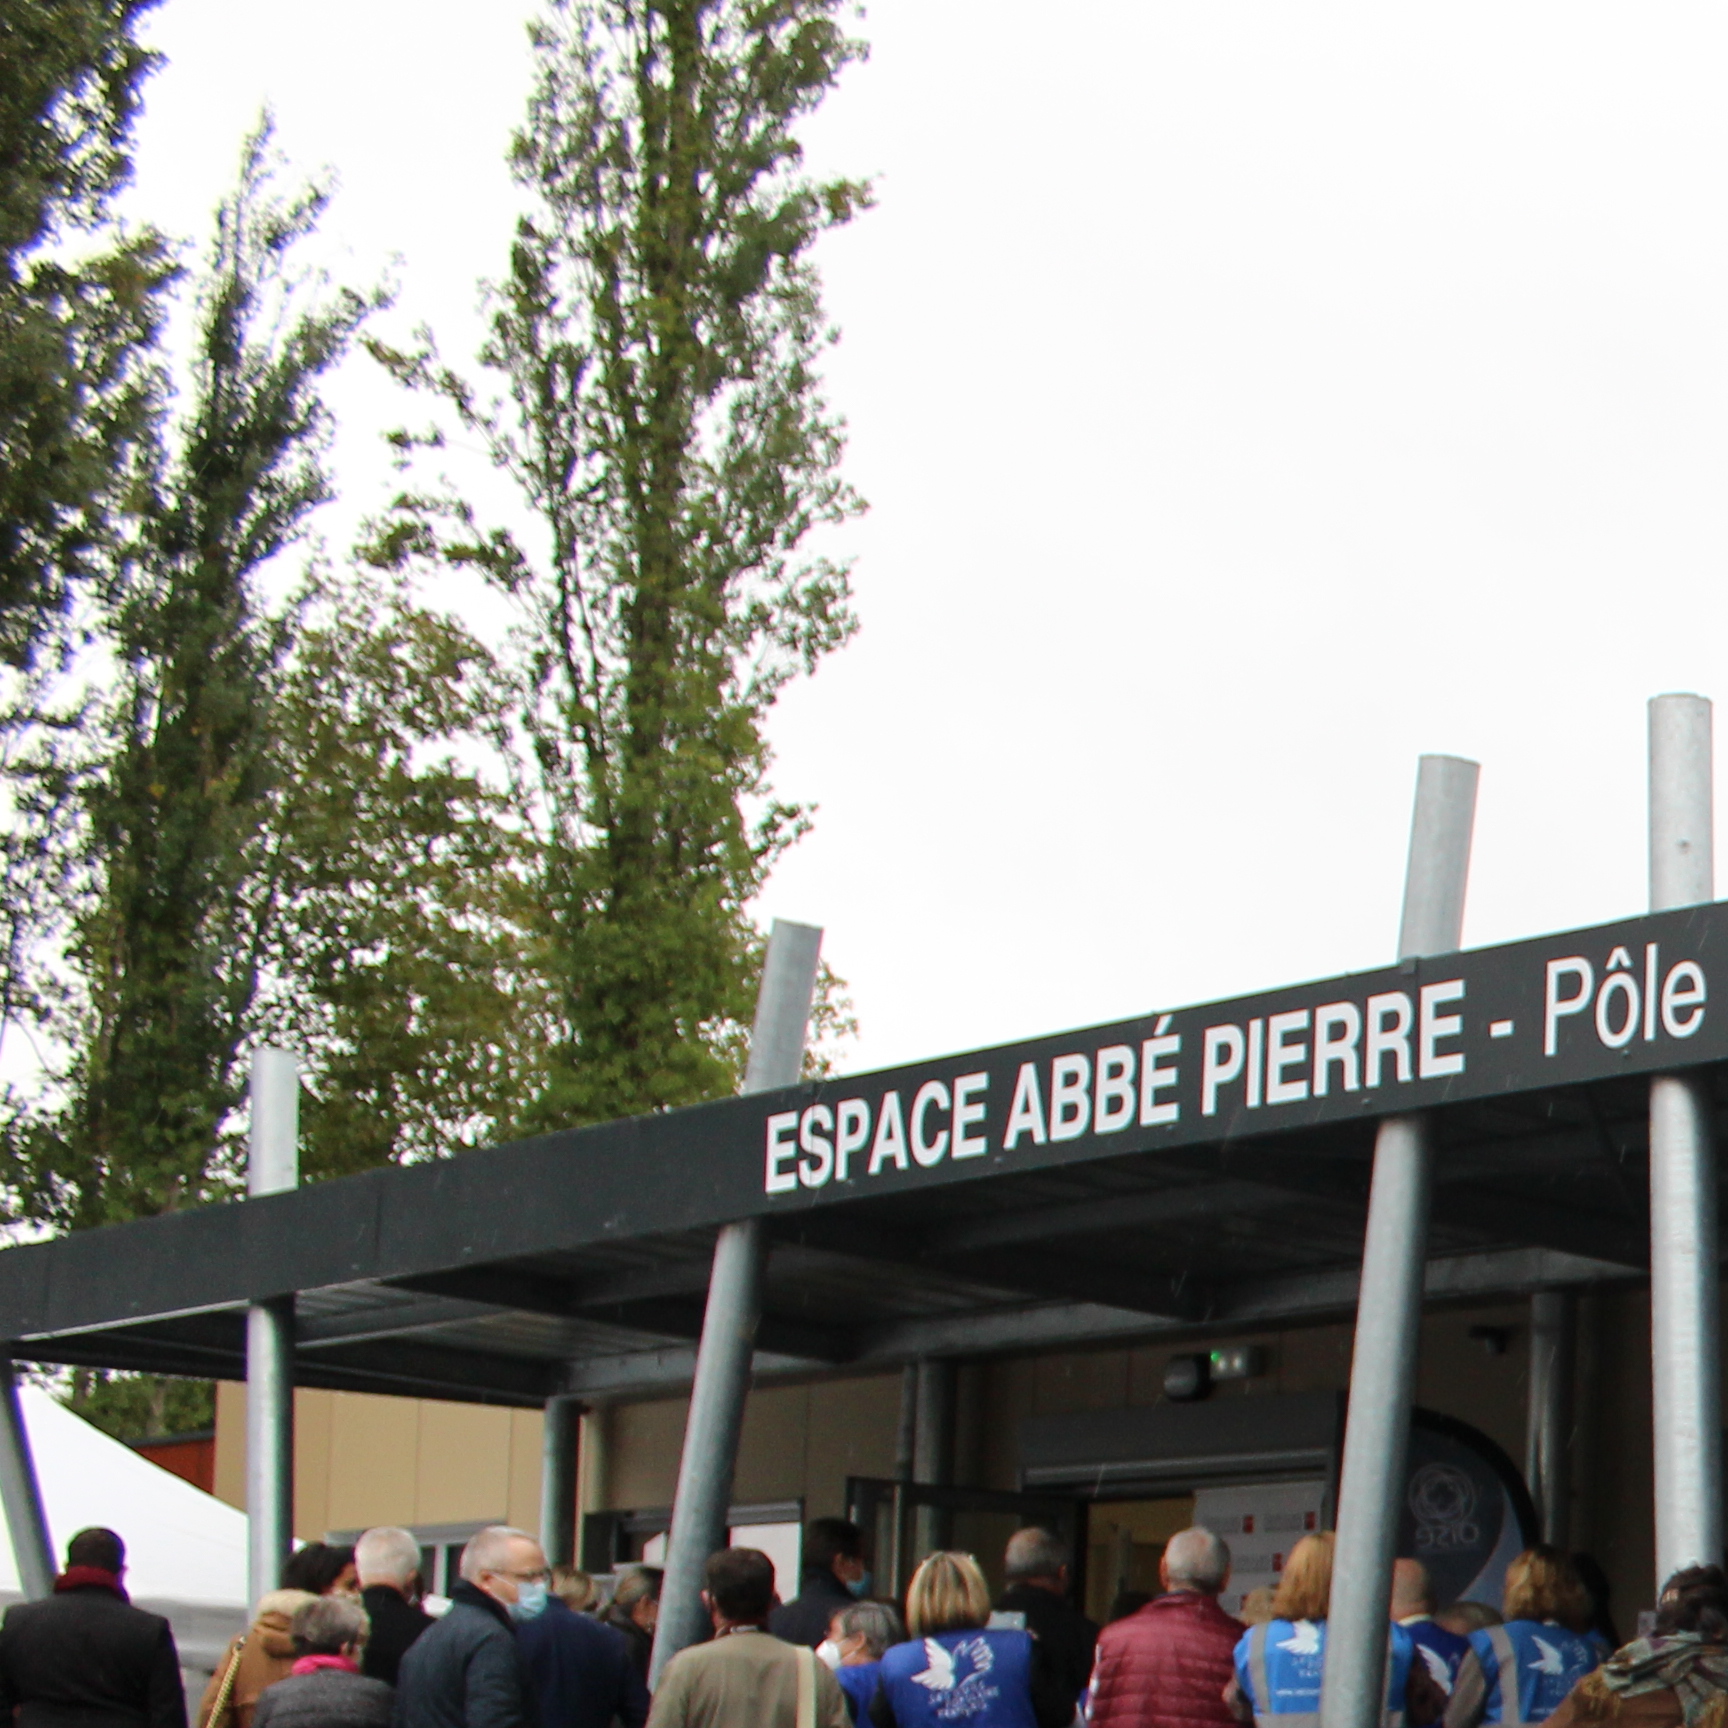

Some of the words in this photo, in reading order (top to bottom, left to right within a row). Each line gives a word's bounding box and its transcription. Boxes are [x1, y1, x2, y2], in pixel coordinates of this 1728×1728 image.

[765, 1072, 987, 1193] ESPACE
[1003, 1014, 1180, 1149] ABBÉ
[1202, 979, 1464, 1115] PIERRE
[1490, 1020, 1513, 1038] -
[1544, 943, 1706, 1056] Pôle
